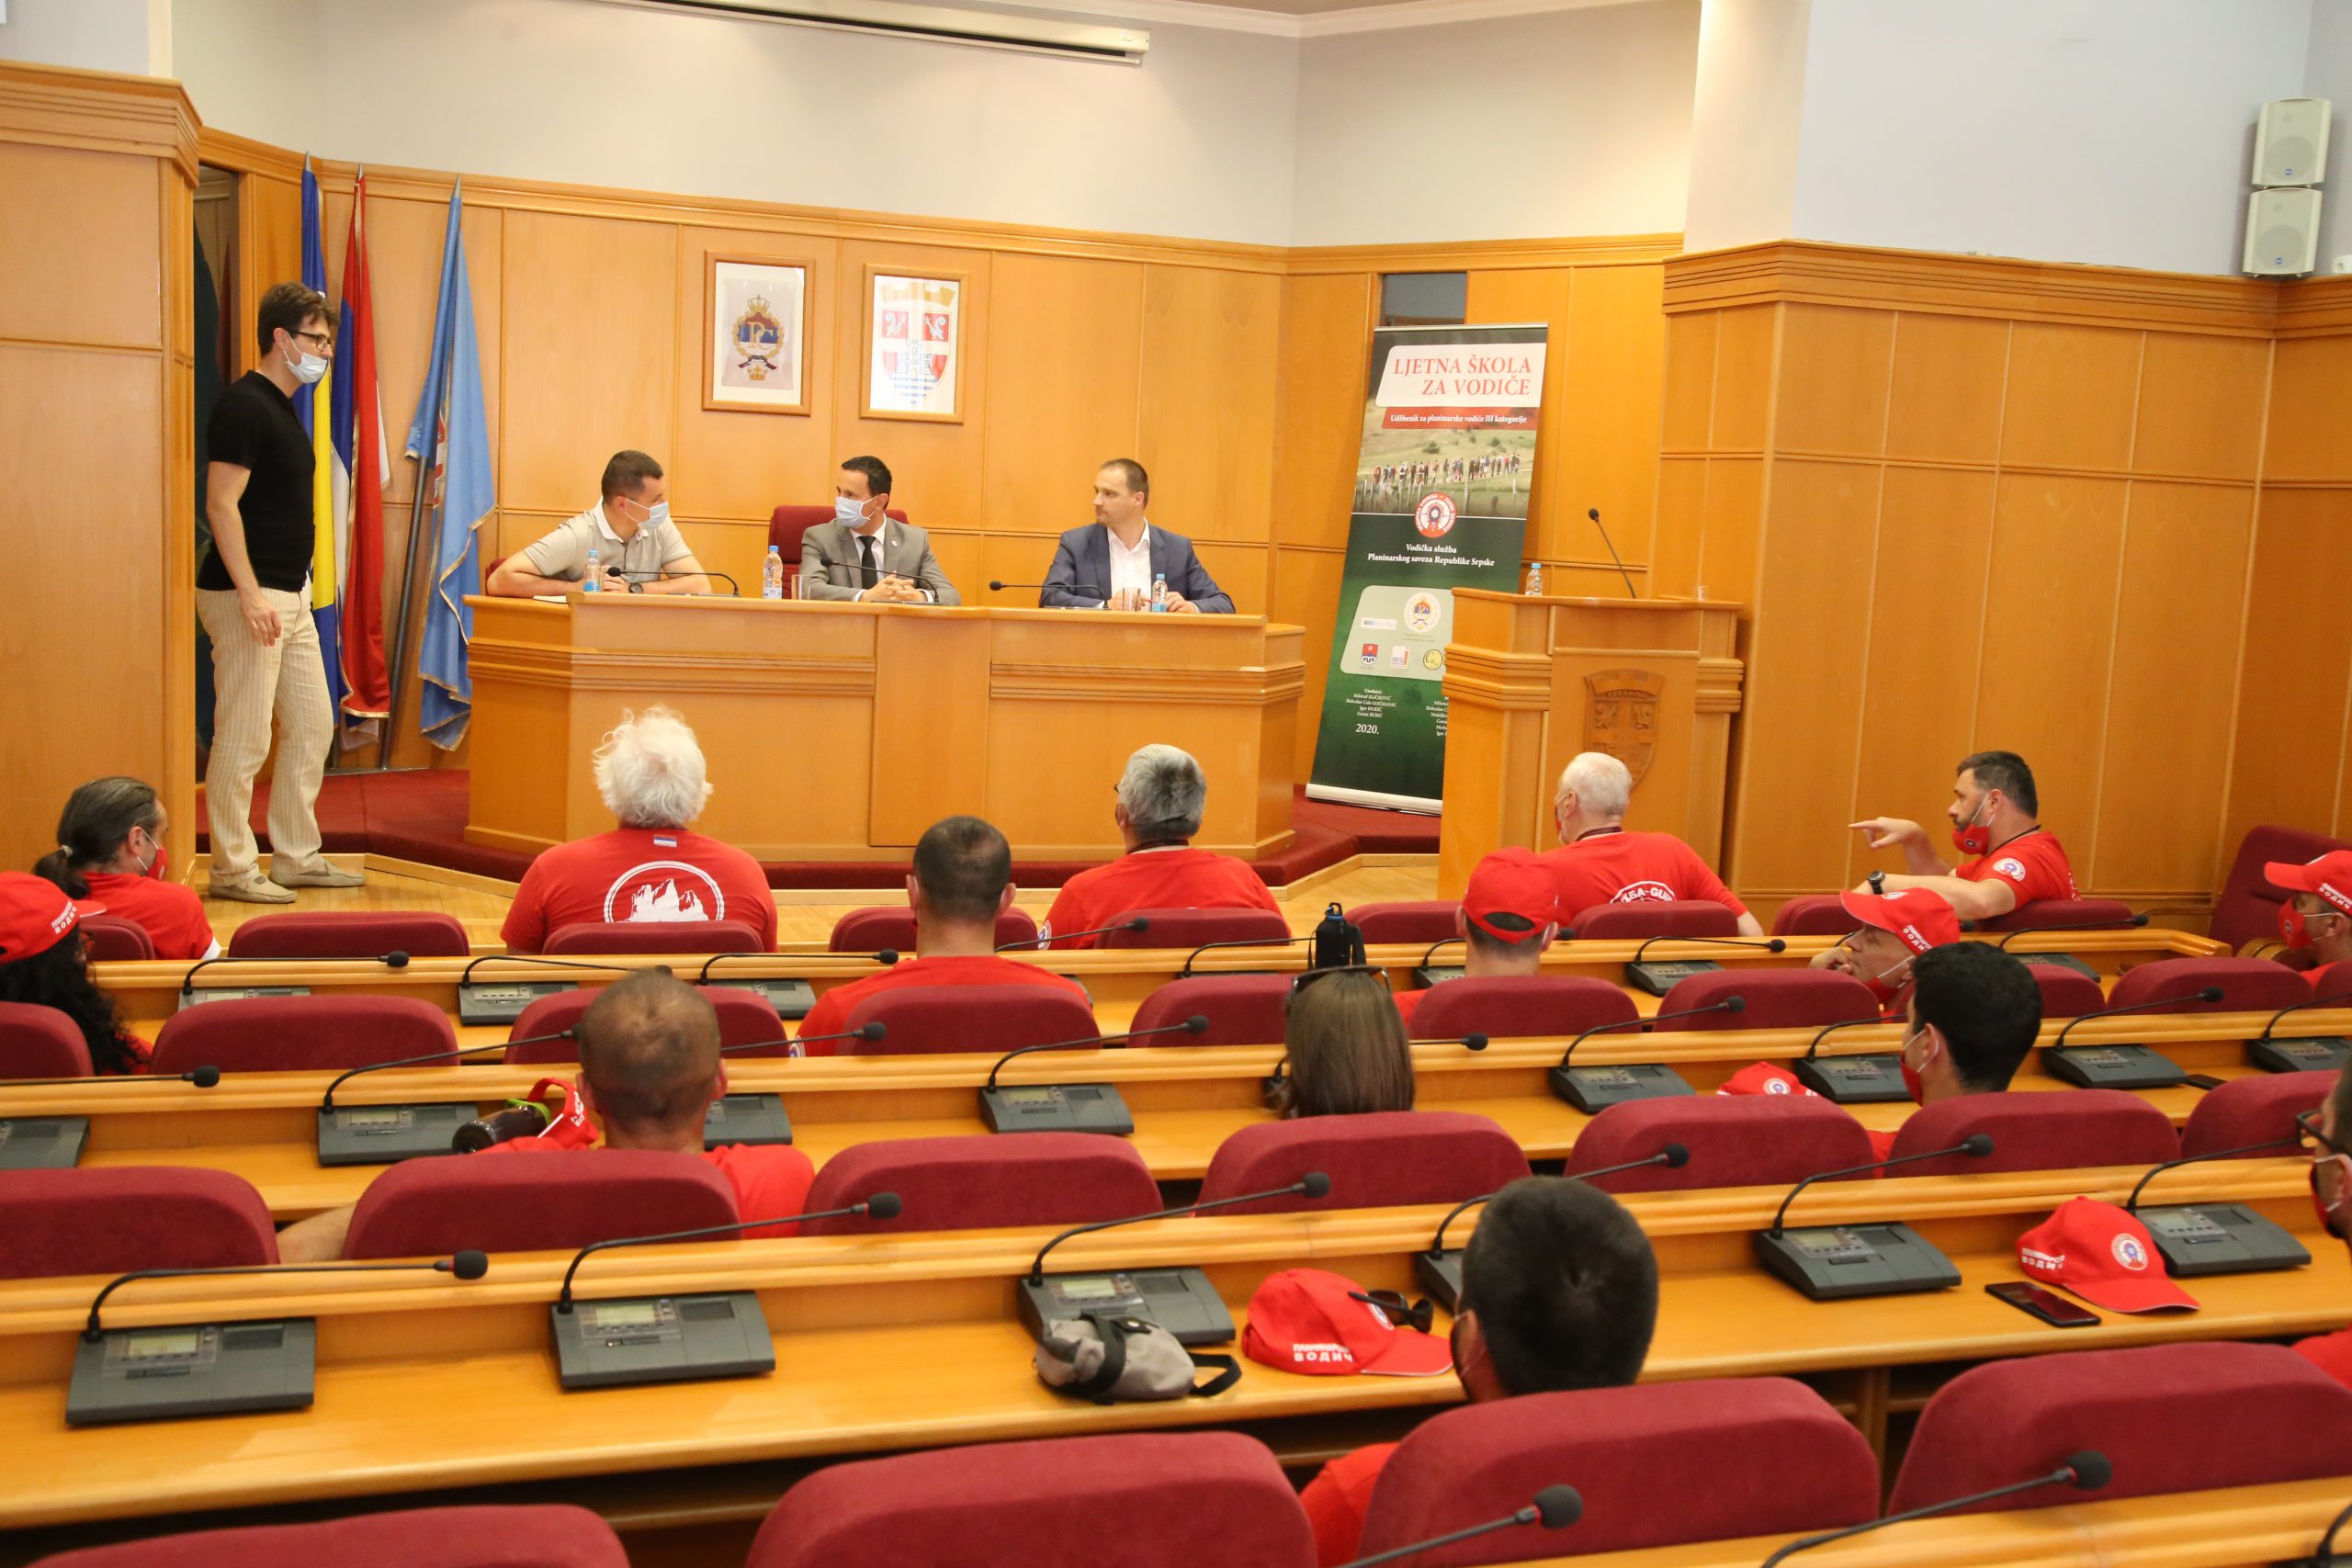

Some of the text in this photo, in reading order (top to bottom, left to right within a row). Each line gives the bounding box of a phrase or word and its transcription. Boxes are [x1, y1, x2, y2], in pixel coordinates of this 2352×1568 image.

[1394, 355, 1532, 378] LJETNA ŠKOLA
[1422, 376, 1530, 395] ZA VODIČE
[1390, 414, 1419, 423] Udžbenik
[1427, 414, 1464, 423] planinarske
[1495, 414, 1527, 424] kategorije
[1406, 544, 1457, 553] Vodička služba
[1368, 553, 1410, 563] Planinarskog
[1434, 556, 1470, 565] Republike
[1471, 558, 1495, 568] Srpske
[1355, 723, 1379, 735] 2020.
[1294, 1351, 1353, 1362] ВОДИЧ
